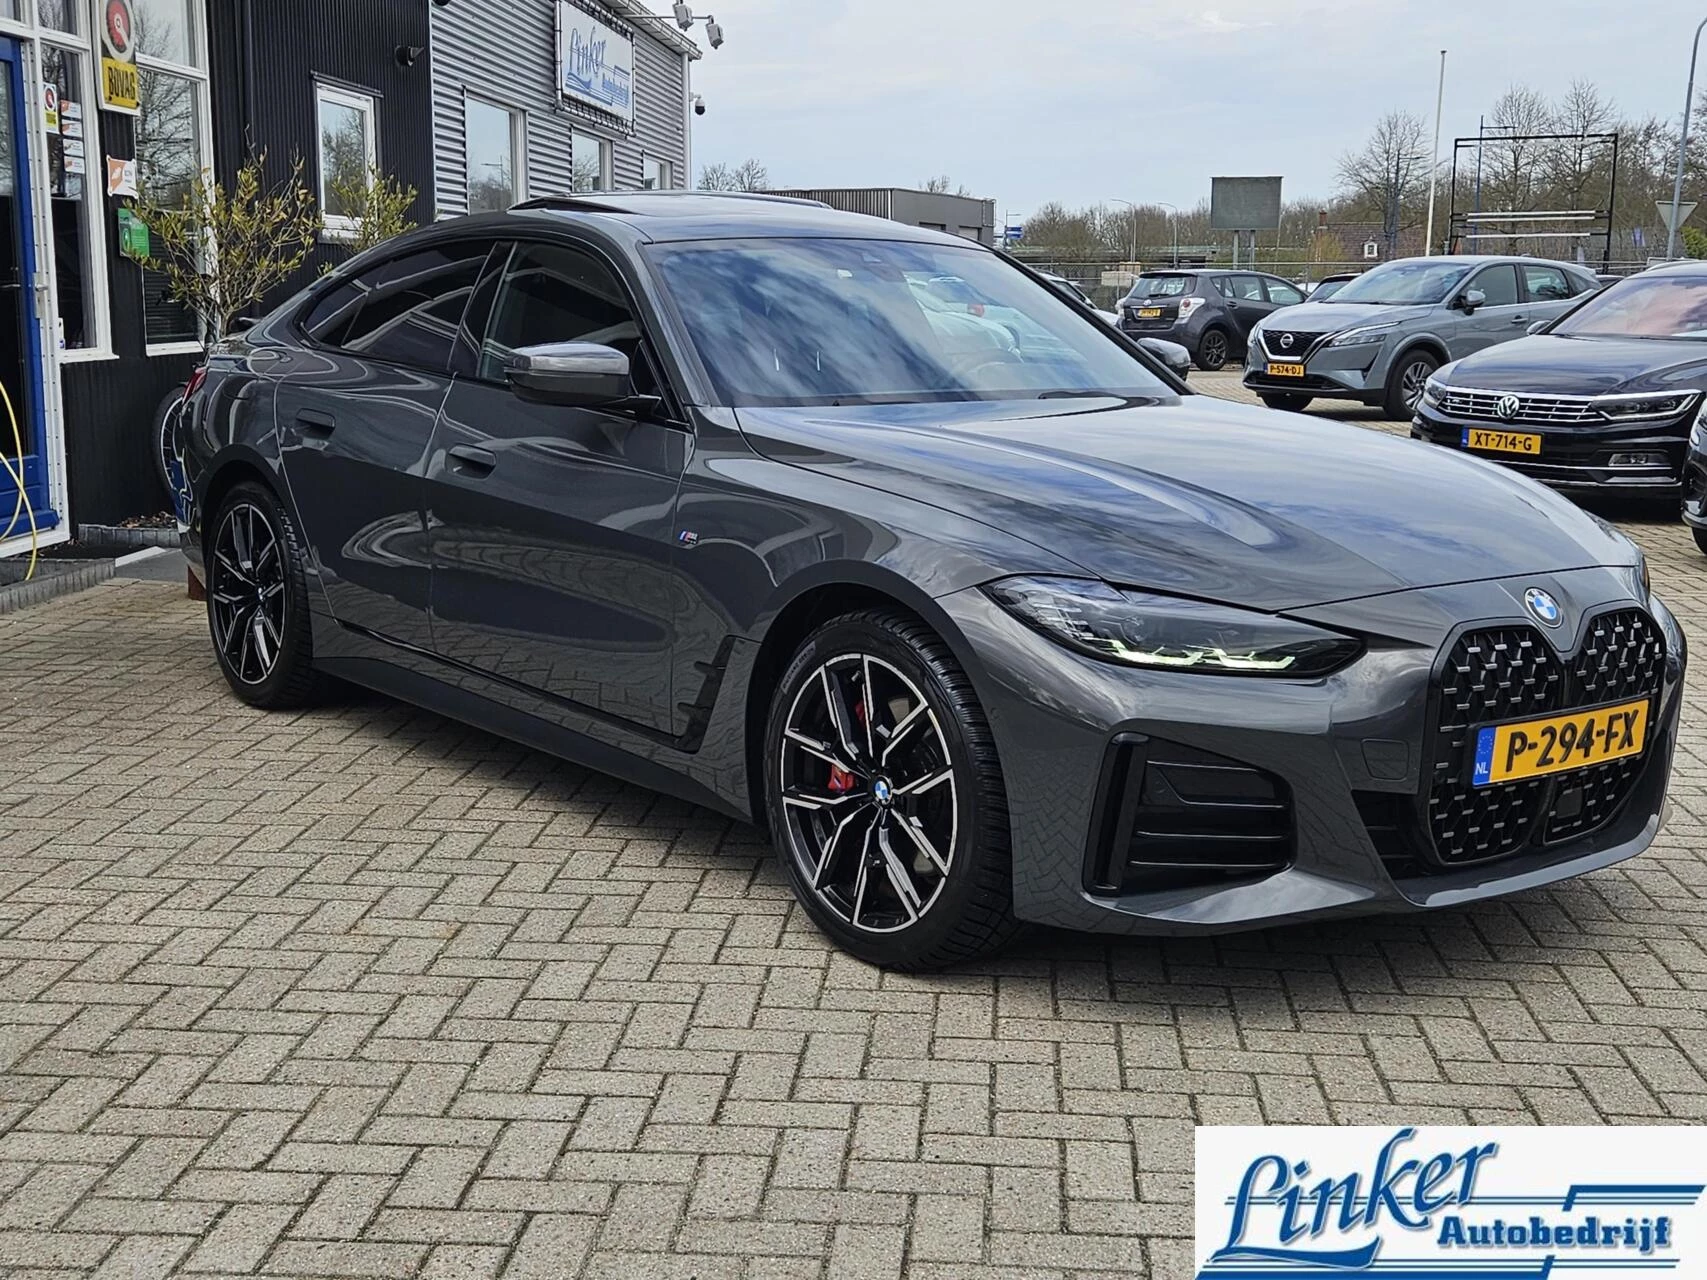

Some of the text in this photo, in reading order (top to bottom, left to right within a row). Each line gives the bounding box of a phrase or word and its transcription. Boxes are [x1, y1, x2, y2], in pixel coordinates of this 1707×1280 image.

[107, 66, 136, 100] BOVAG
[1269, 364, 1302, 375] P-574-DJ
[1474, 431, 1532, 451] XT-714-G
[1505, 709, 1639, 773] P-294-FX
[1475, 762, 1489, 775] NL
